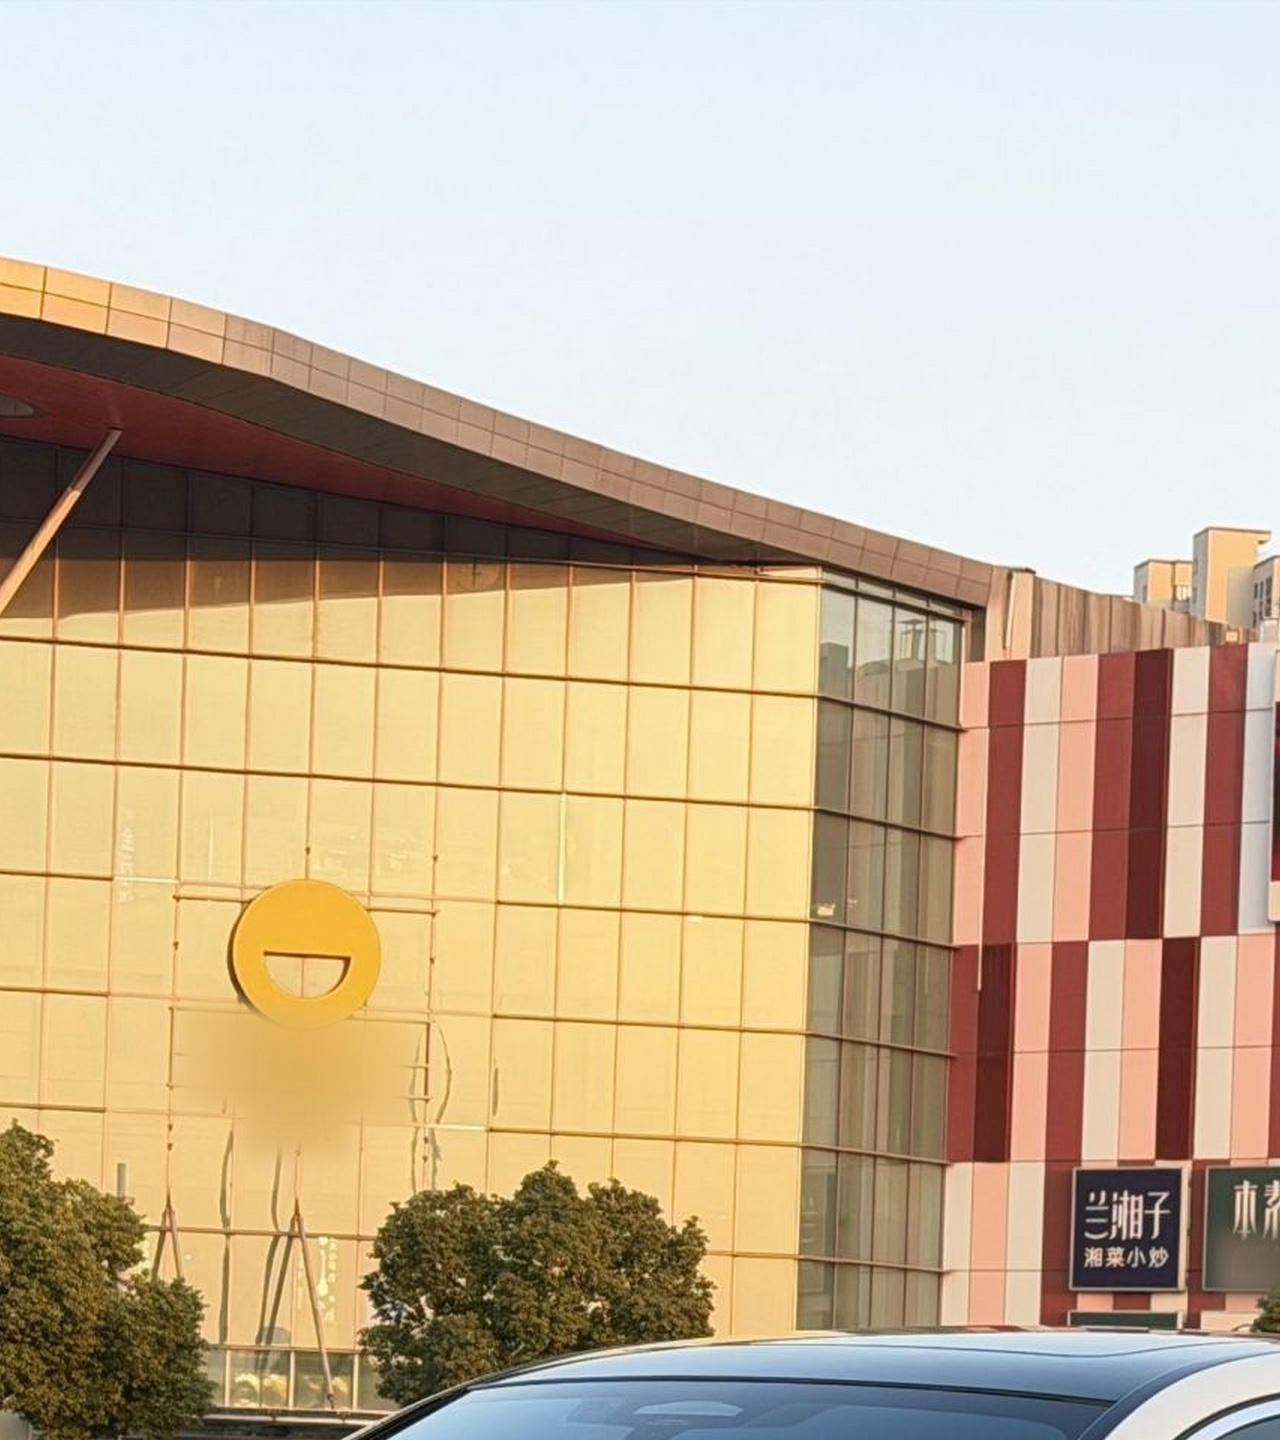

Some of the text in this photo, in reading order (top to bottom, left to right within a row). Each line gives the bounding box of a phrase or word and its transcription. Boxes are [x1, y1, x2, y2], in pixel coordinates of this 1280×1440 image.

[1084, 1189, 1172, 1241] 兰湘子
[1083, 1246, 1170, 1268] 湘菜小炒
